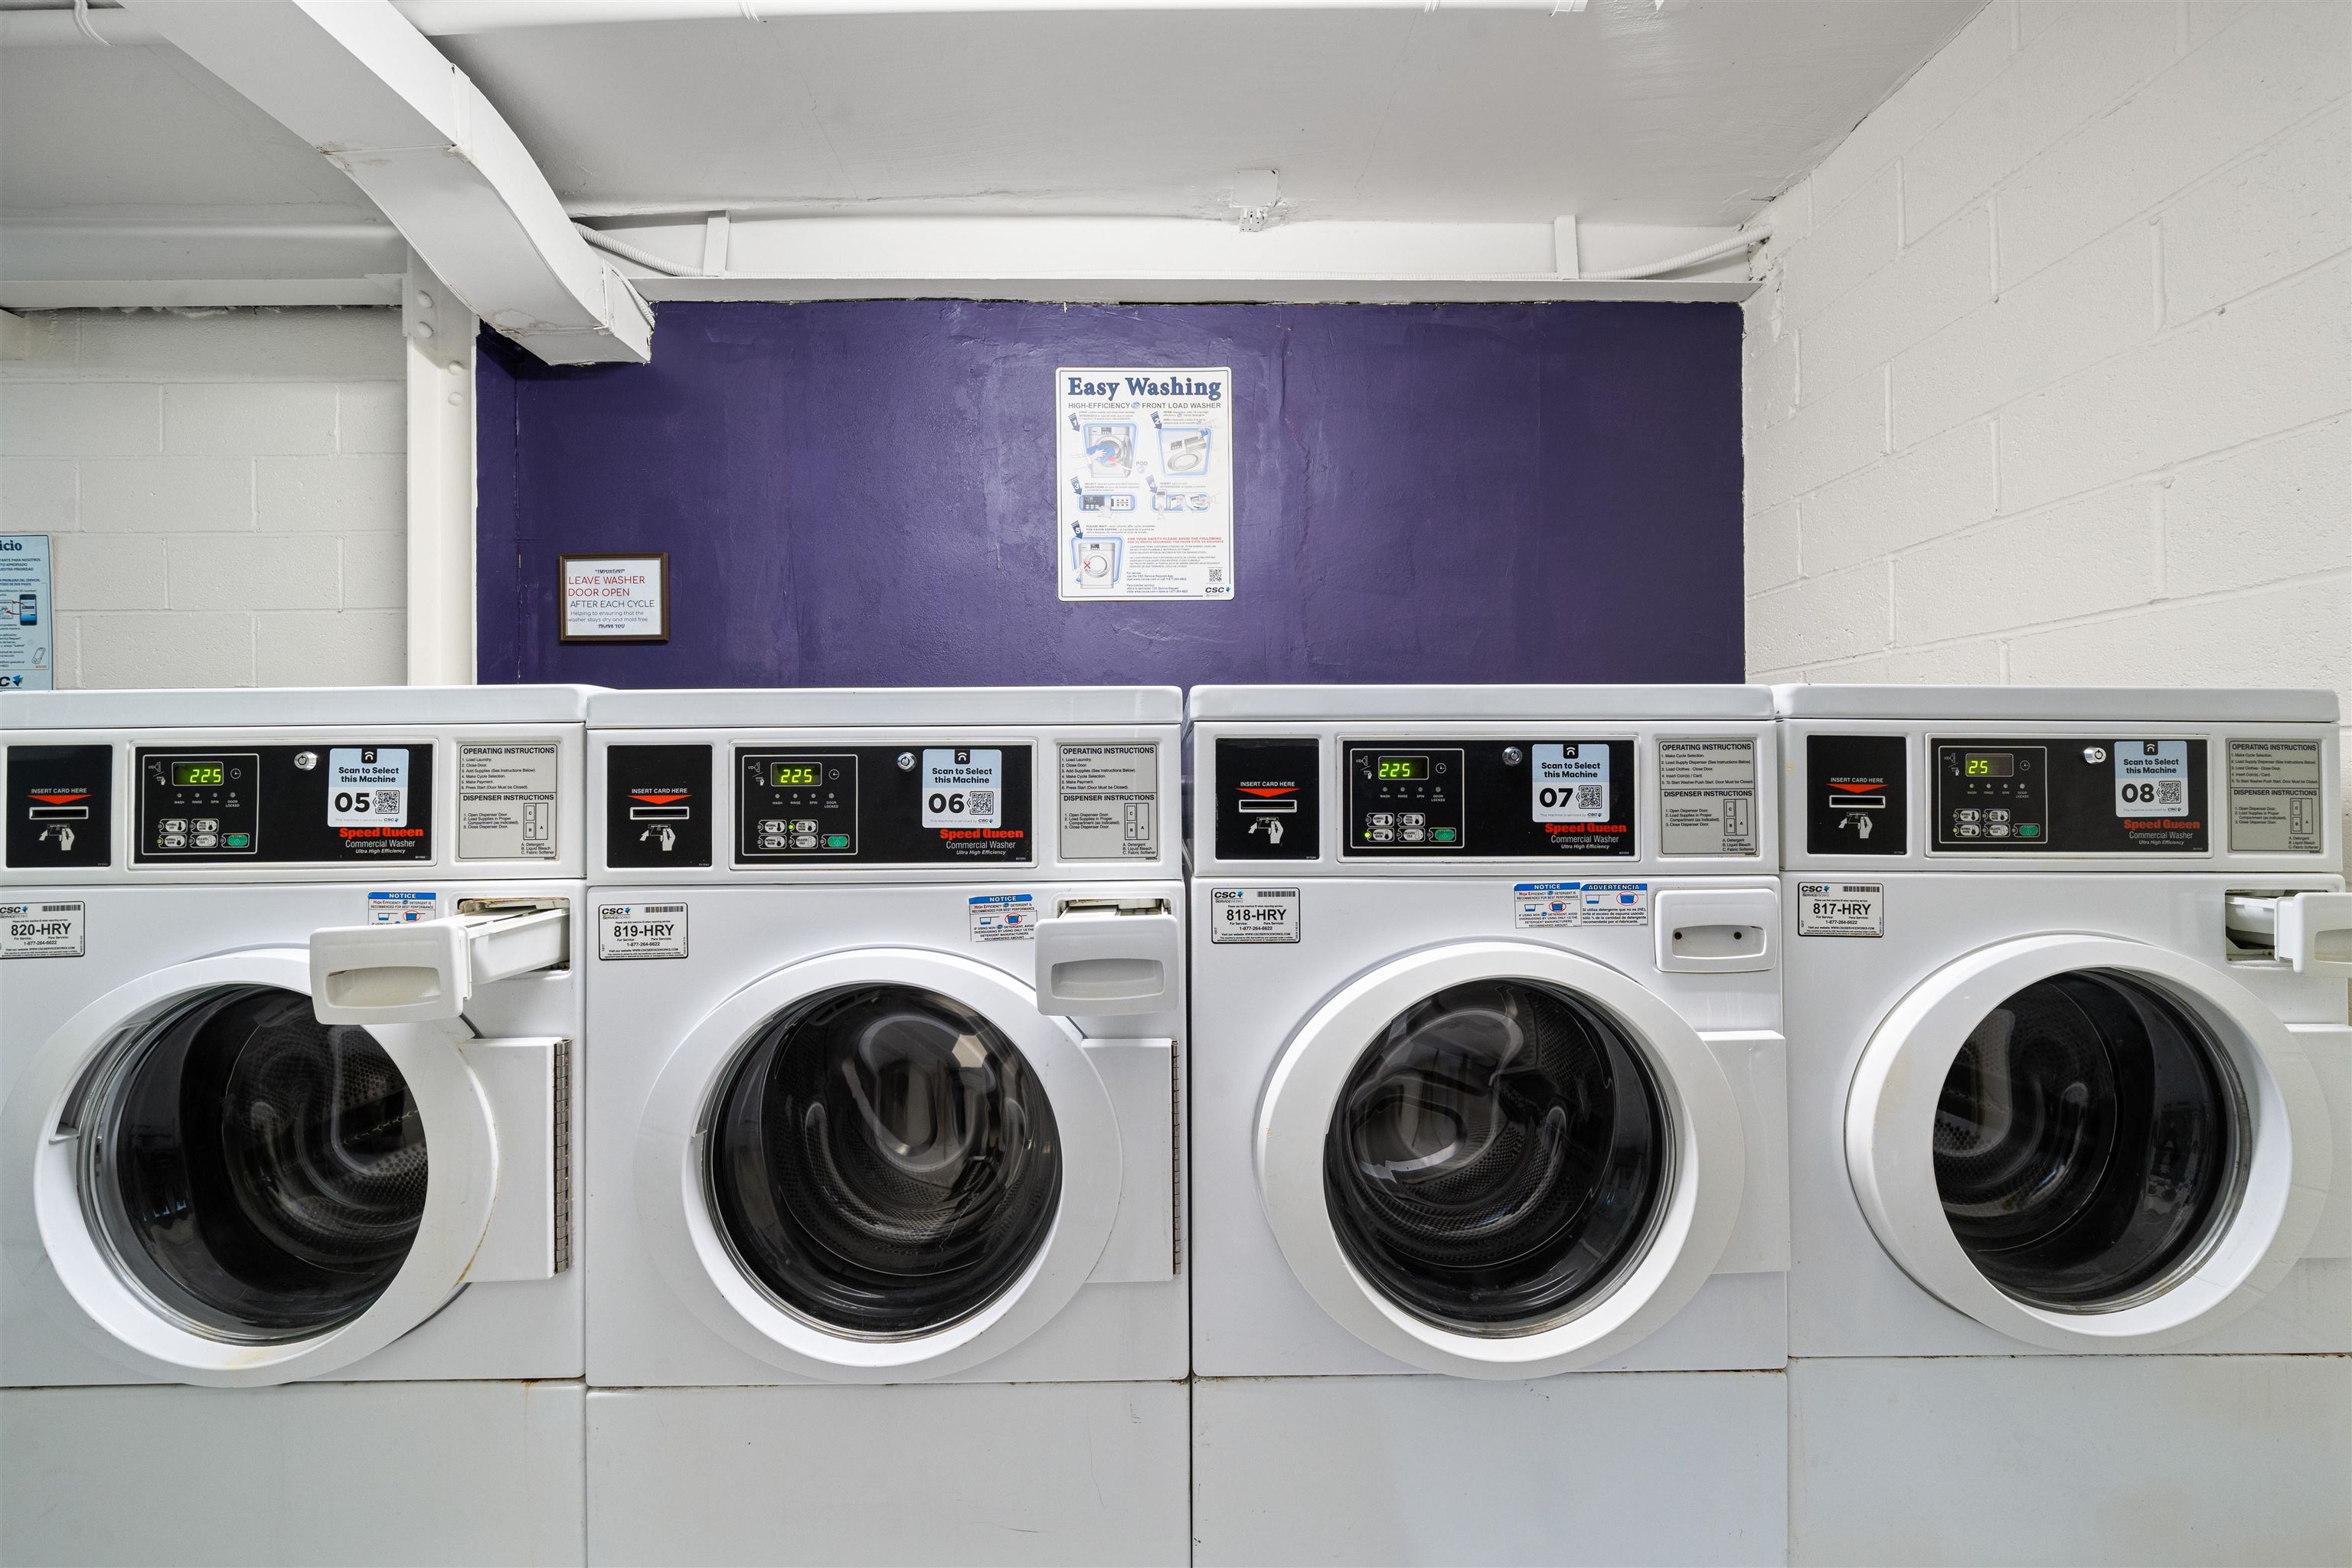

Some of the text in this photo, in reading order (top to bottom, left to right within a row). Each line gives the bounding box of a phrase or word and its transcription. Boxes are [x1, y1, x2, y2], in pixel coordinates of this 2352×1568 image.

[1068, 377, 1221, 401] Easy Washing
[603, 576, 645, 584] WASHER
[602, 588, 629, 596] OPEN
[1380, 763, 1410, 777] 225
[1968, 761, 1988, 773] 25
[190, 769, 221, 782] 225
[781, 769, 812, 782] 225
[1539, 788, 1573, 808] 07
[2122, 783, 2154, 803] 08
[335, 792, 371, 812] 05
[928, 793, 965, 813] 06
[1545, 823, 1626, 835] Speed Queen
[2124, 819, 2200, 830] Speed Queen
[339, 827, 423, 839] Speed Queen
[940, 828, 1024, 841] Speed Queen
[1551, 835, 1592, 843] Commercial
[1227, 909, 1286, 921] 818-HRY
[1813, 903, 1871, 915] 817-HRY
[11, 923, 71, 936] 820-HRY
[614, 924, 674, 937] 819-HRY
